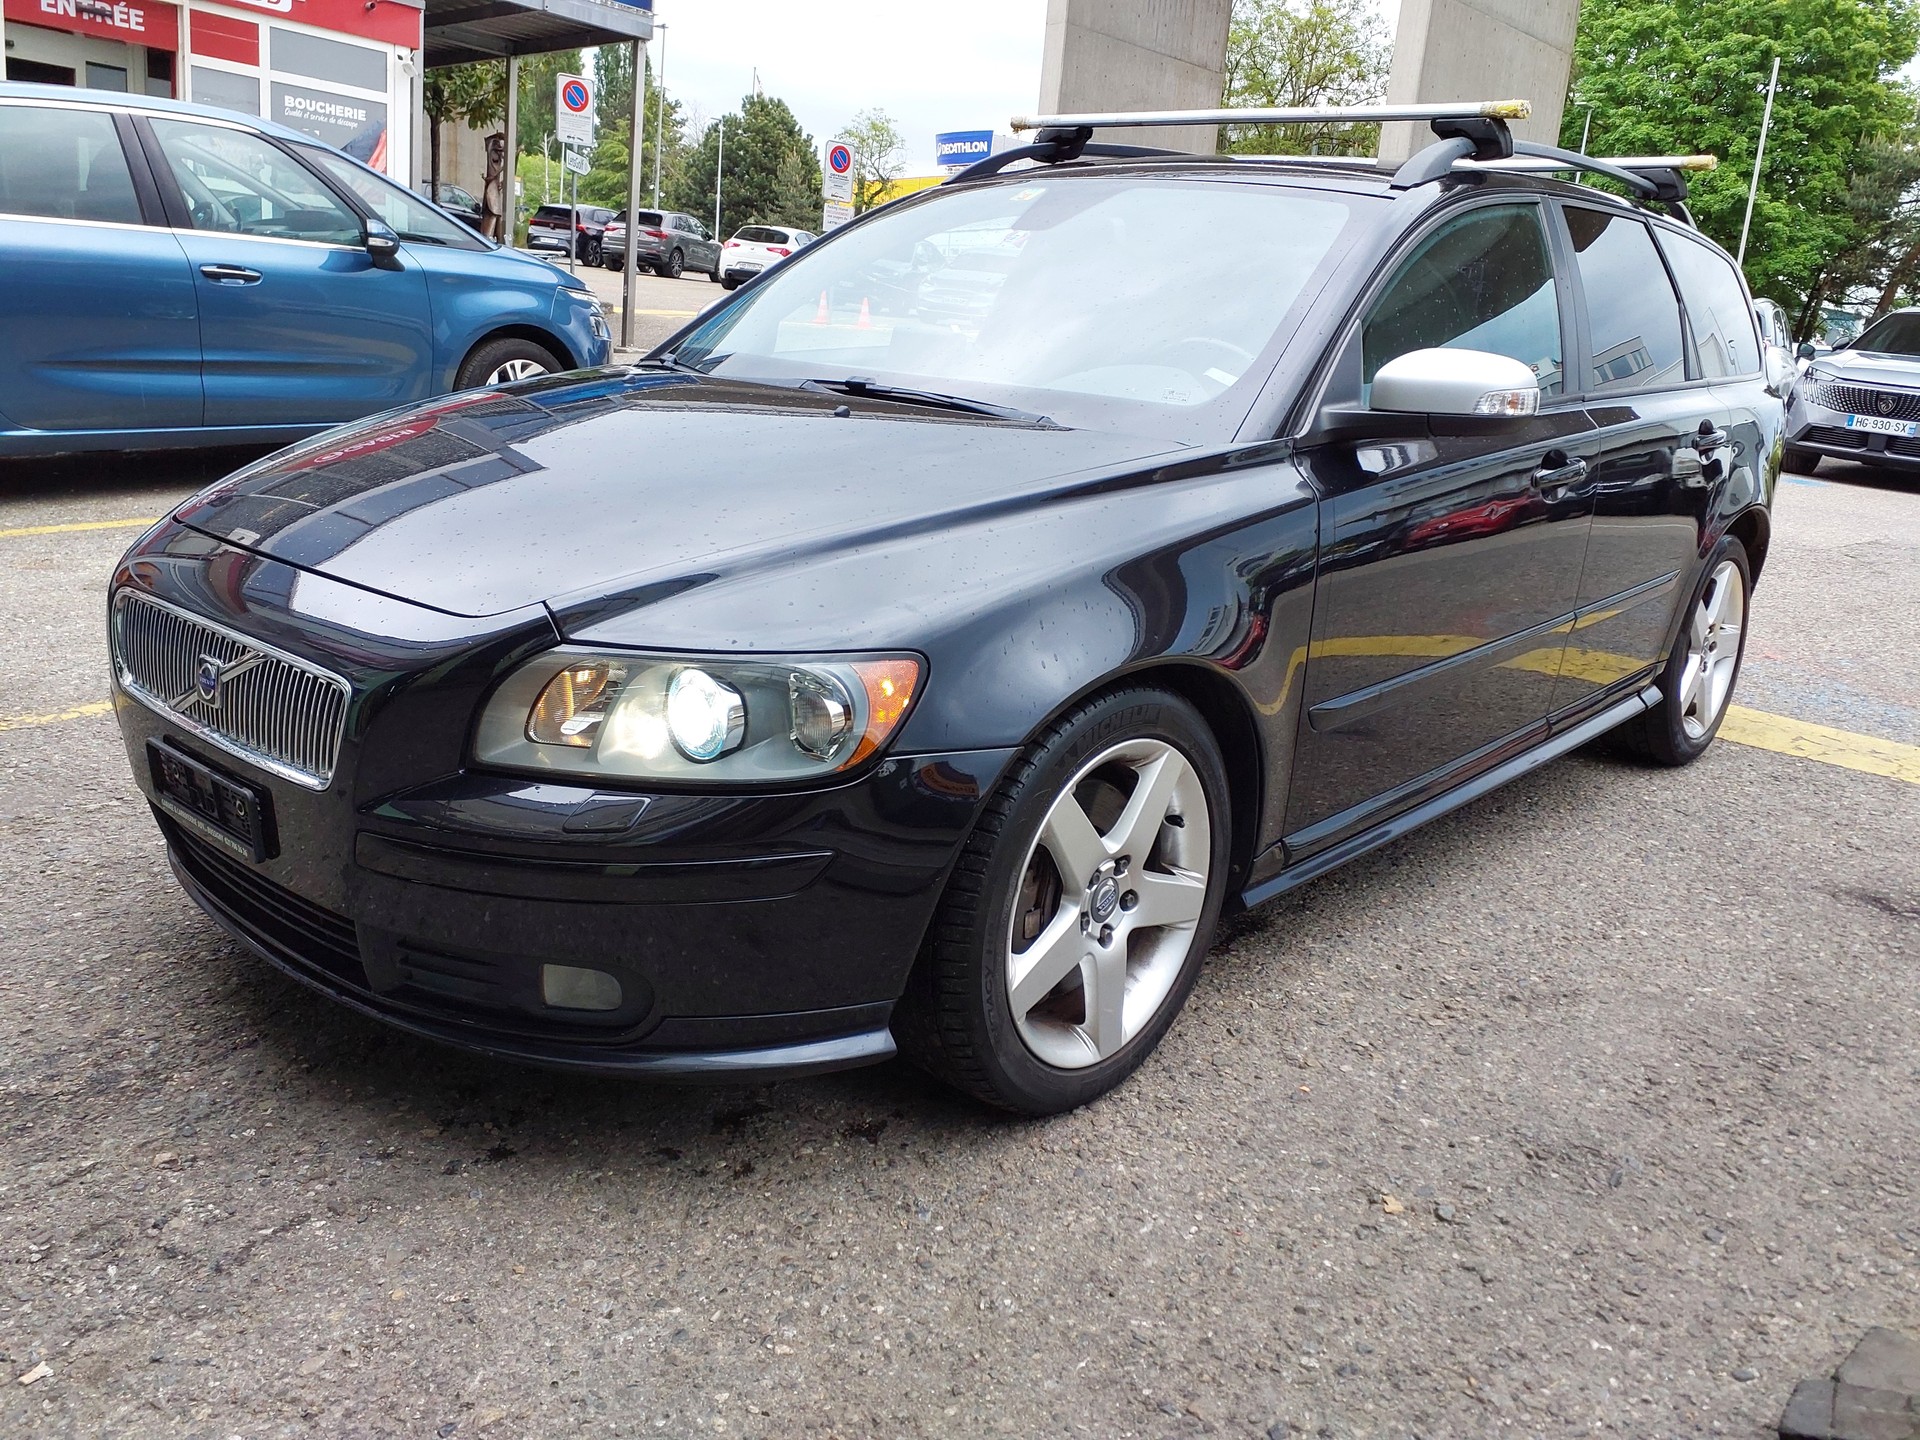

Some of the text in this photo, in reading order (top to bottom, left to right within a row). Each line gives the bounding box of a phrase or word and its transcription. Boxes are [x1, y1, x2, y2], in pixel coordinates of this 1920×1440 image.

[284, 95, 367, 121] BOUCHERIE
[310, 114, 328, 122] service
[941, 141, 988, 155] DECATHLON
